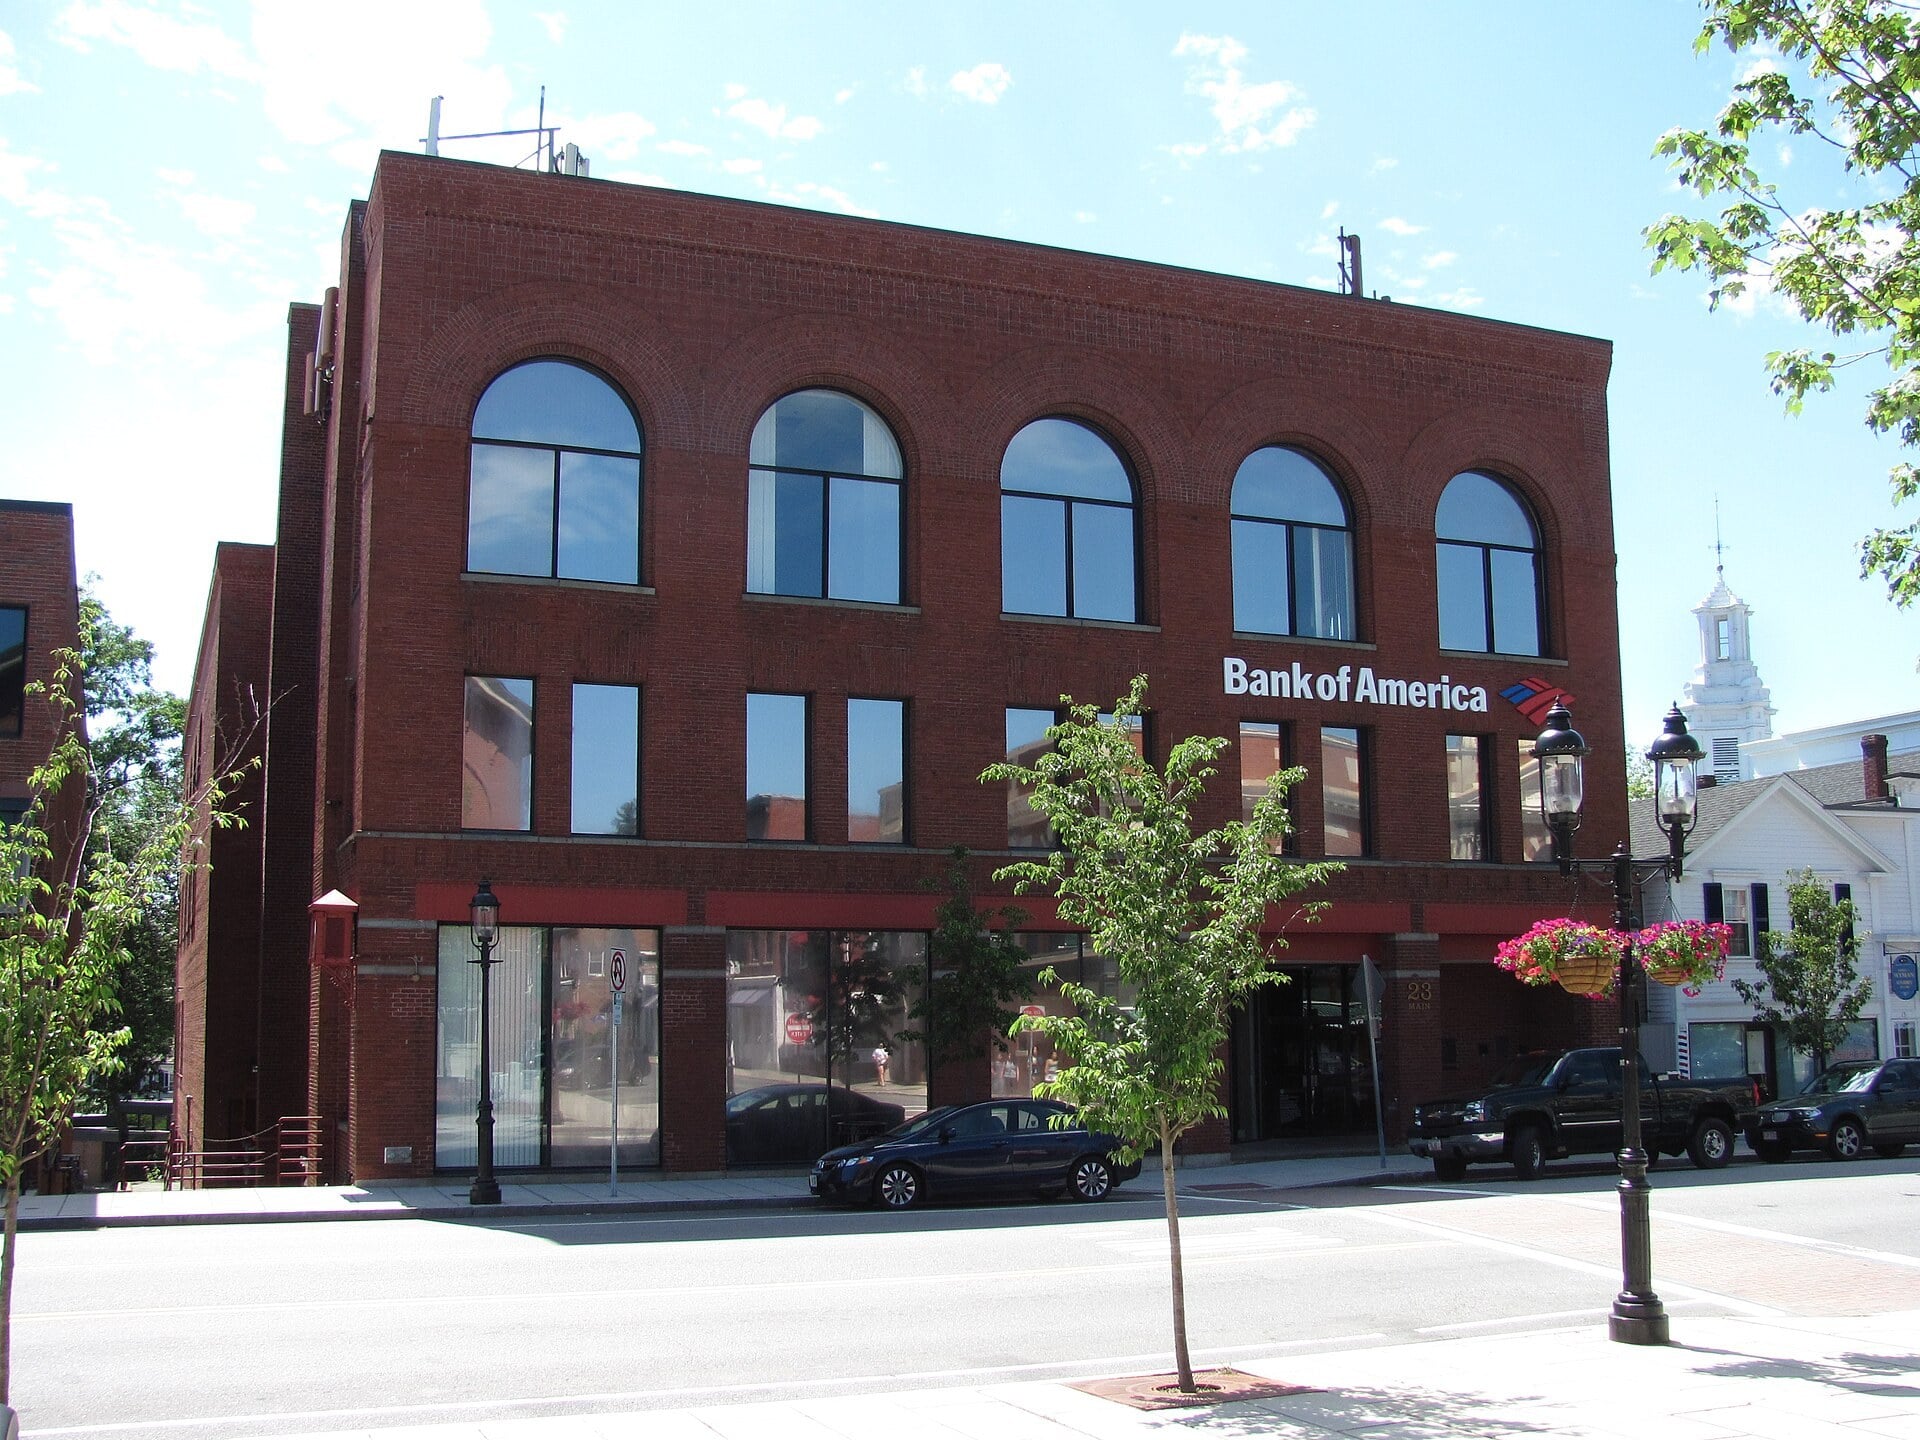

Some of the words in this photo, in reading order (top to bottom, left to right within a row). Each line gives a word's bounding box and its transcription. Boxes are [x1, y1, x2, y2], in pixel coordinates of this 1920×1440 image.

[1223, 657, 1314, 700] Bank
[1315, 665, 1351, 702] of
[1354, 667, 1488, 712] America
[1407, 982, 1432, 1001] 23
